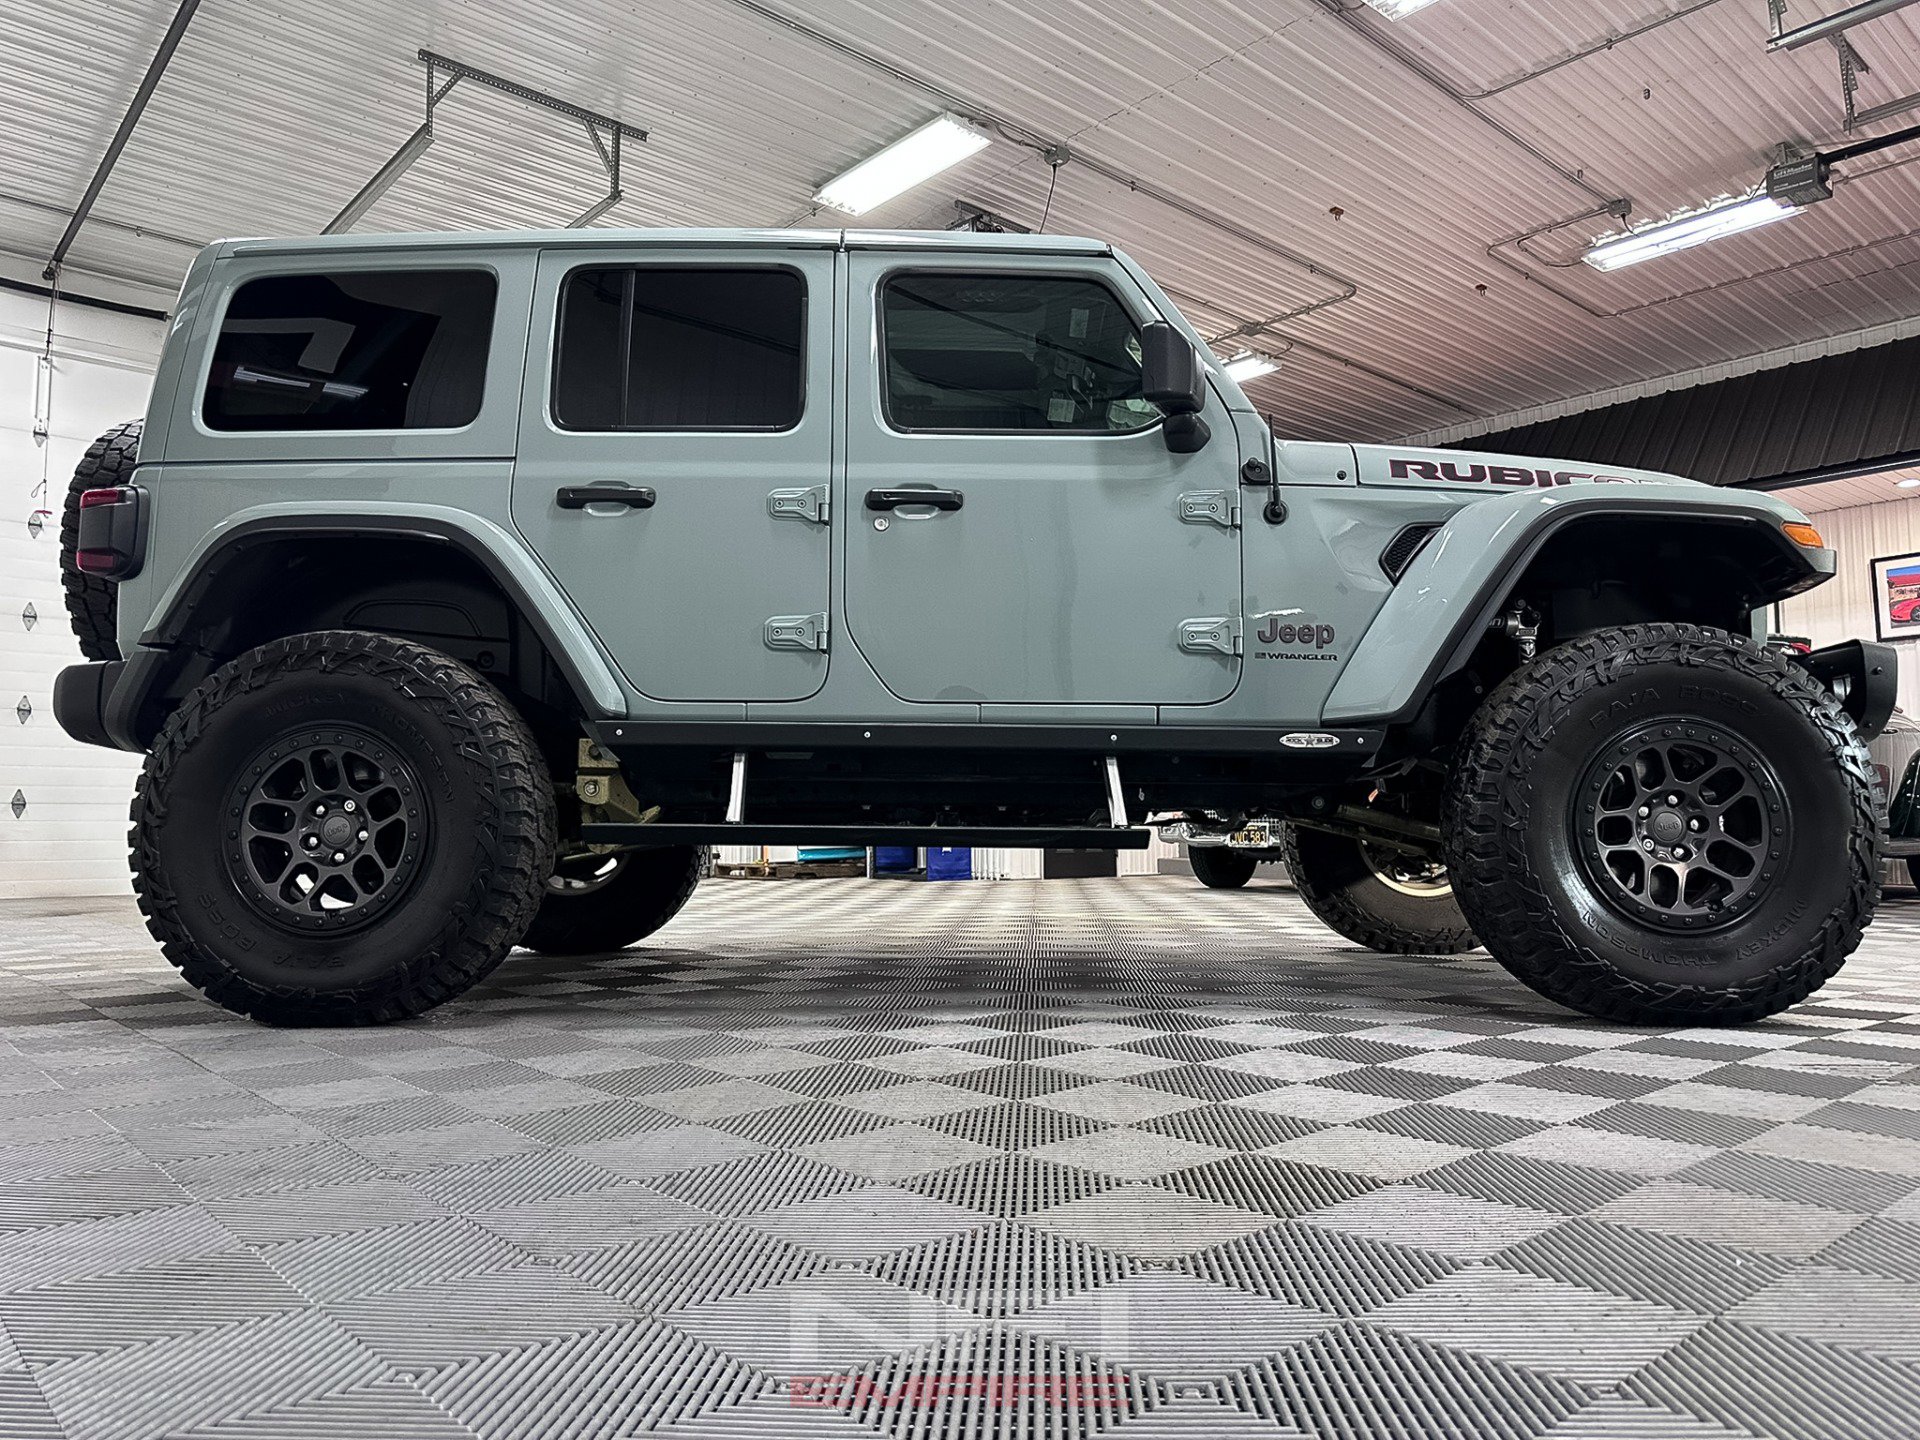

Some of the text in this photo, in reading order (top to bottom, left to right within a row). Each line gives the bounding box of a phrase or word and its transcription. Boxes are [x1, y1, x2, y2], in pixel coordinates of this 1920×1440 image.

[1257, 618, 1335, 649] Jeep
[1267, 652, 1338, 661] WRANGLER
[1582, 900, 1808, 967] MICKEY THOMPSON
